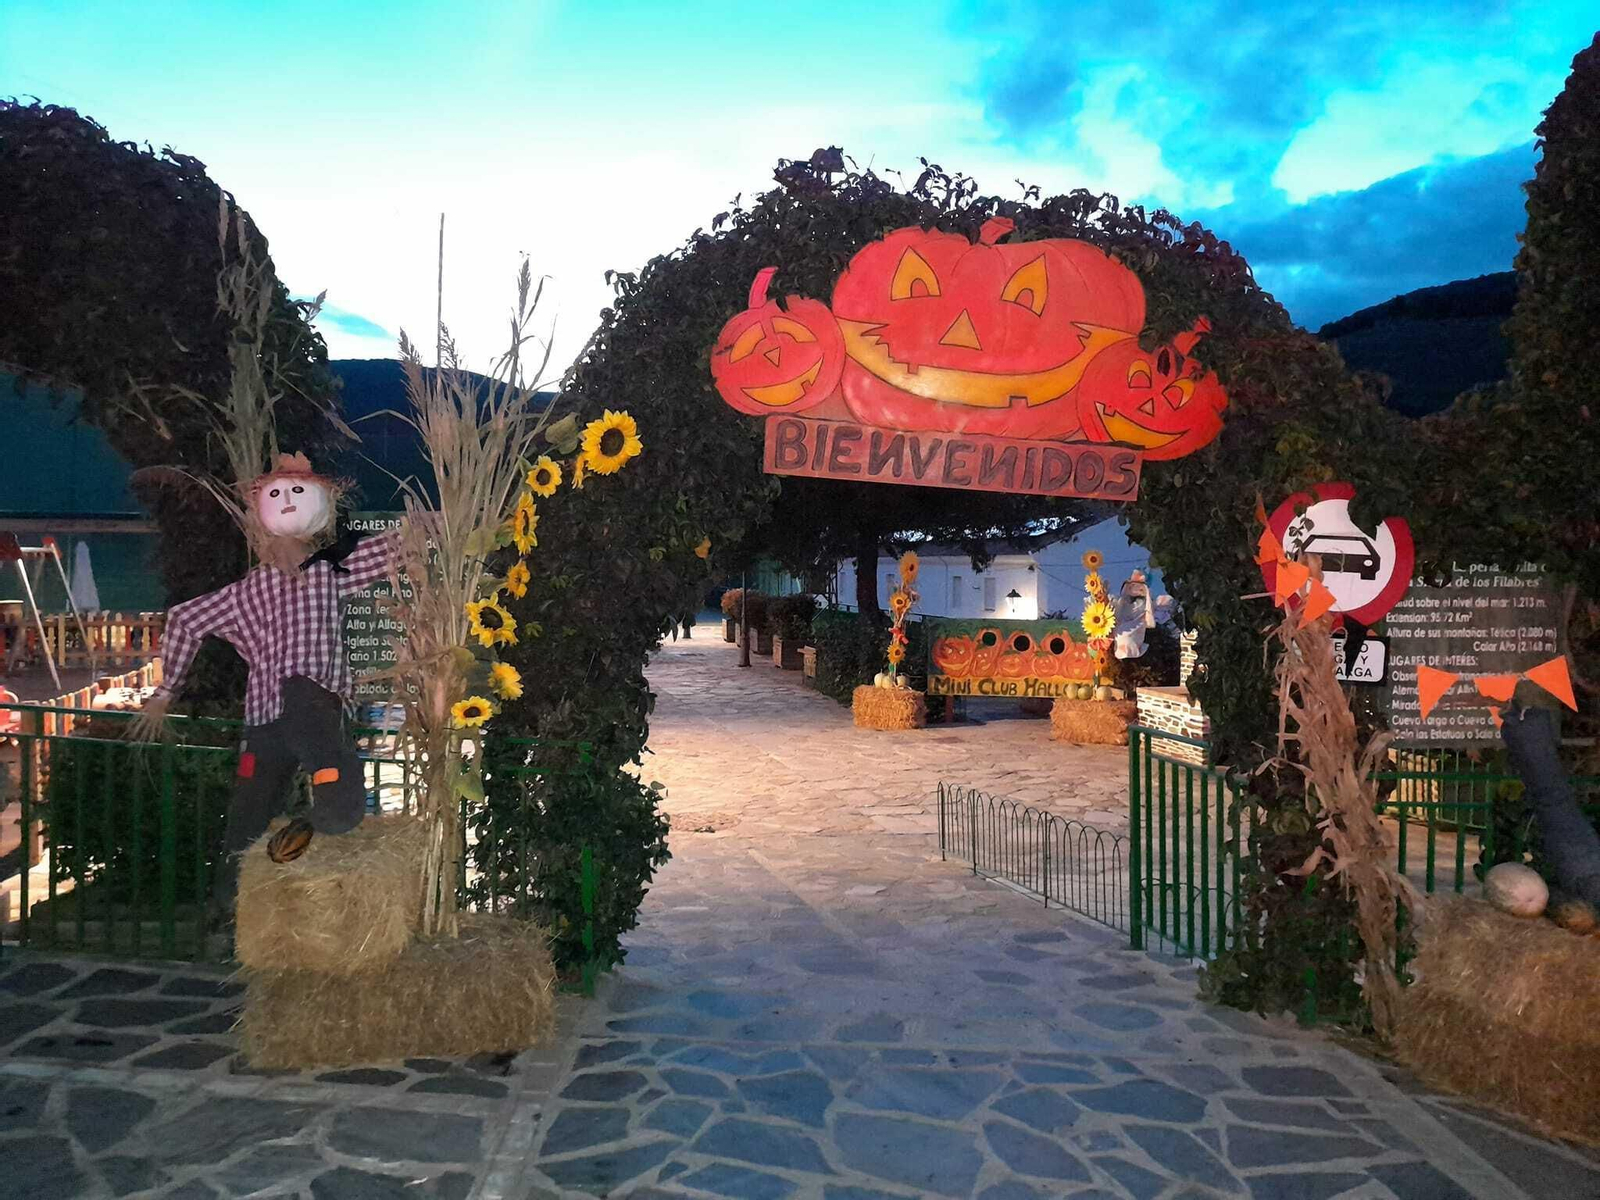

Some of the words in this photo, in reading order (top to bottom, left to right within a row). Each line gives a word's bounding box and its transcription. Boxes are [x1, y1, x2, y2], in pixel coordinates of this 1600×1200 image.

[774, 417, 1136, 495] BIENVENIDOS
[1455, 575, 1470, 587] de
[1472, 576, 1490, 587] los
[1416, 597, 1440, 608] sobre
[1453, 597, 1473, 608] nivel
[1475, 597, 1489, 608] del
[347, 604, 371, 614] Zona
[1386, 627, 1412, 638] Altura
[1414, 627, 1426, 638] de
[1428, 629, 1441, 638] sus
[1428, 655, 1440, 666] DE
[978, 677, 1017, 696] CLUB
[1391, 715, 1420, 725] Cueva
